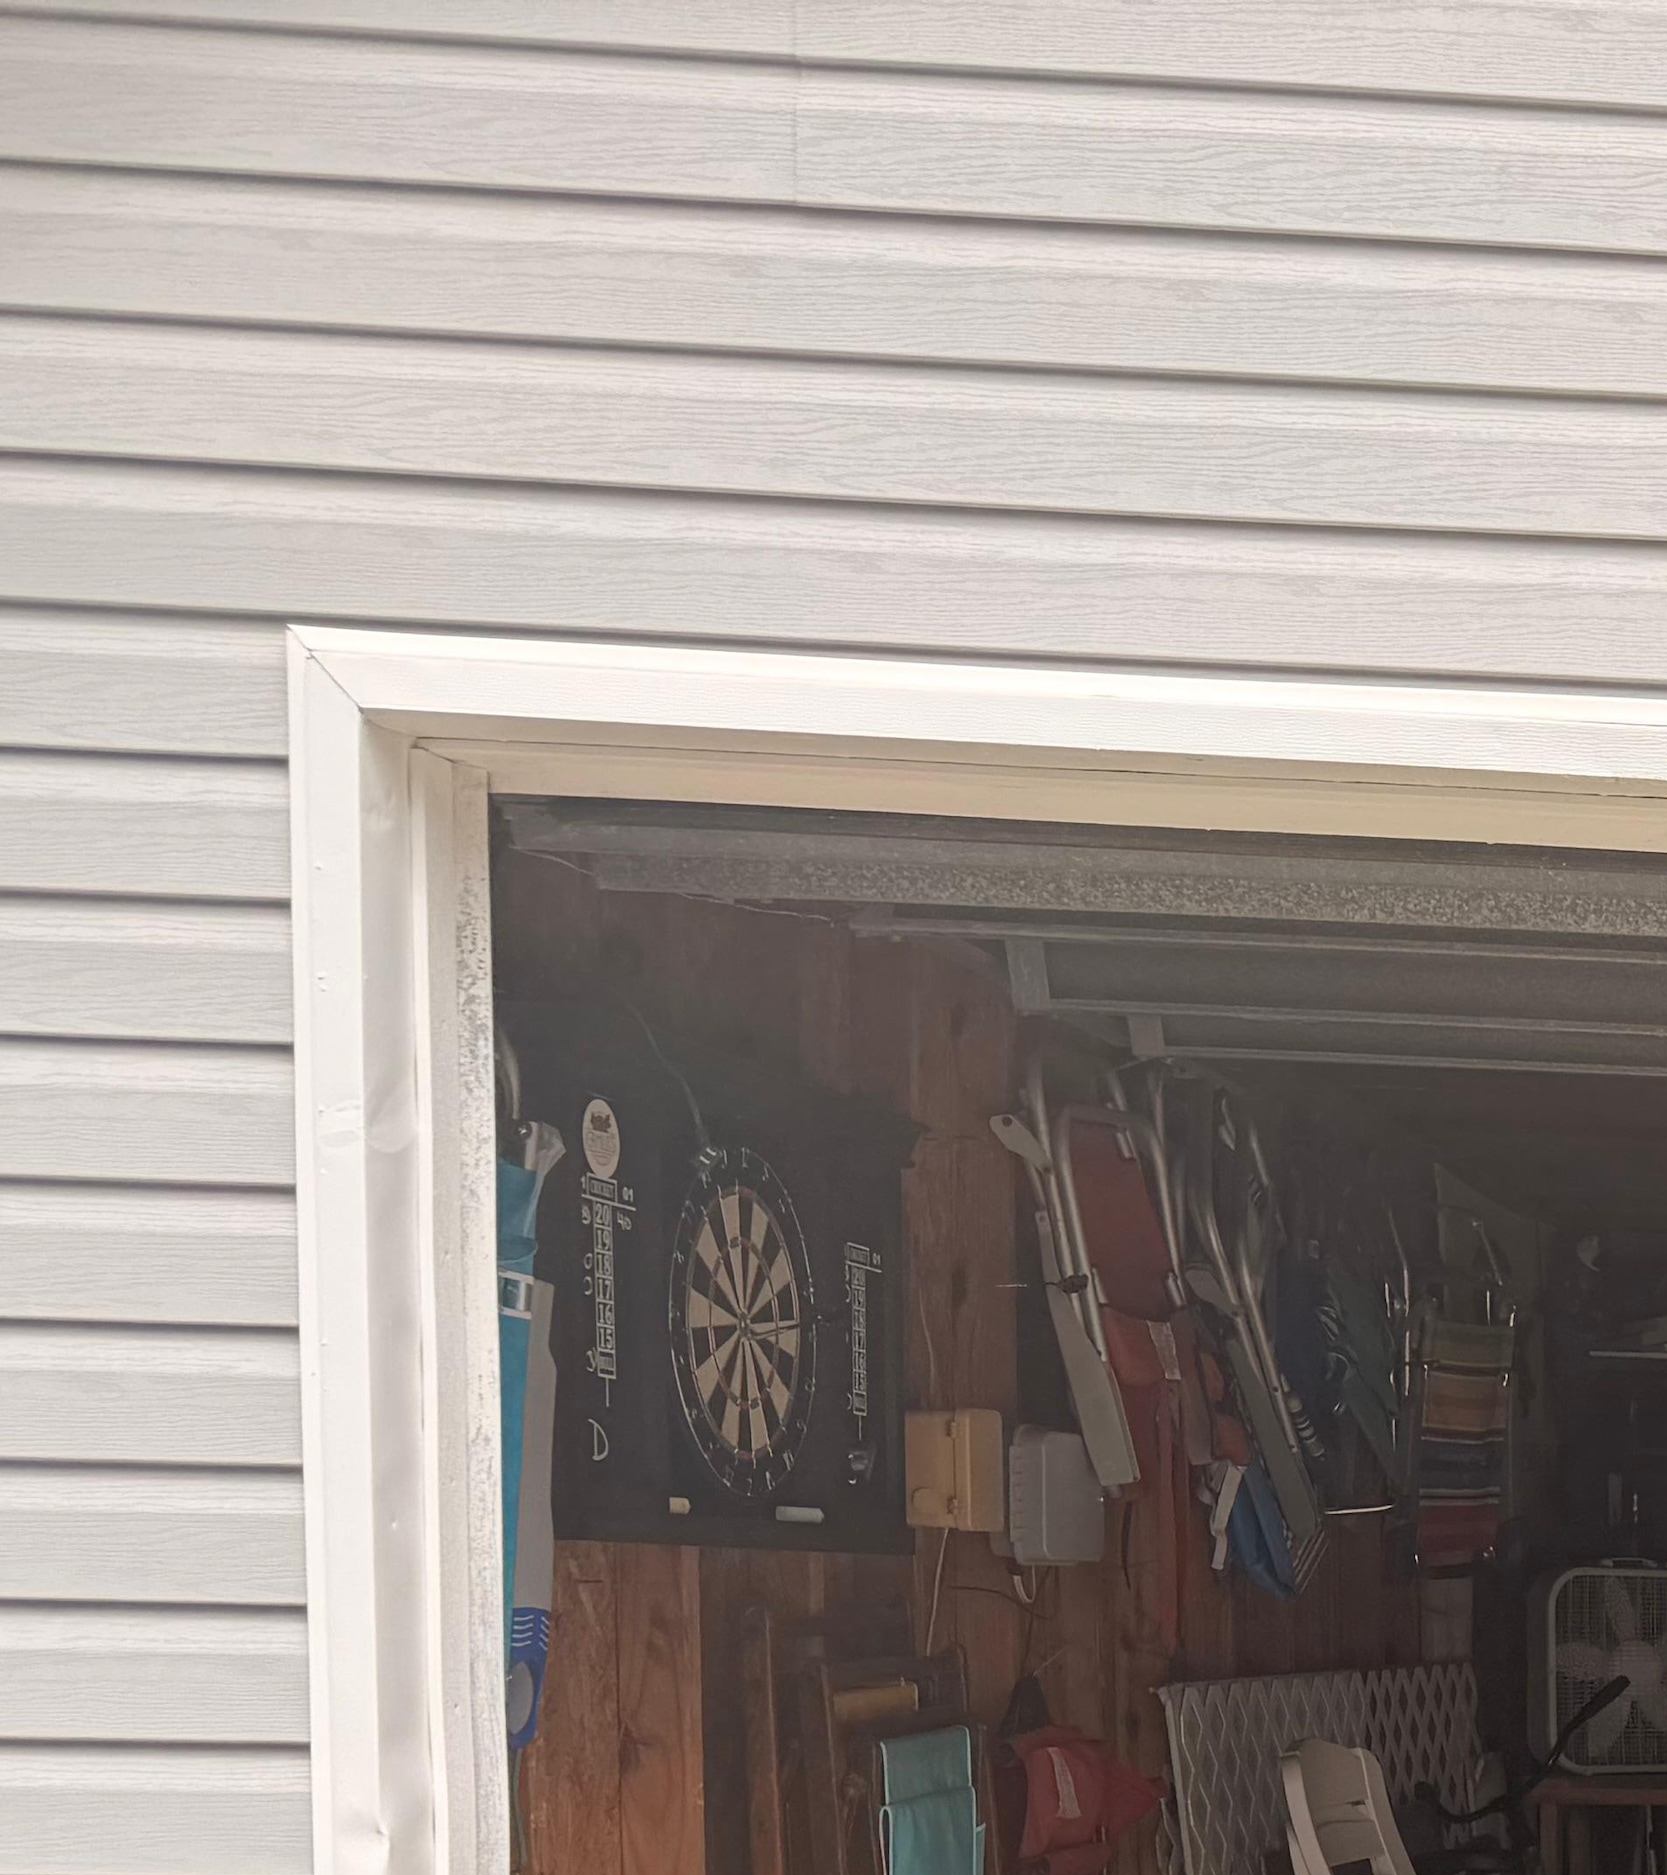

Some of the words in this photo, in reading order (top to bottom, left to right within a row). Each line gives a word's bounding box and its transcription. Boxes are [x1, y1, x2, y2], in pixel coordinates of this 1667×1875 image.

[595, 1203, 611, 1227] 20
[596, 1228, 611, 1251] 19
[597, 1253, 613, 1277] 18
[598, 1279, 612, 1300] 17
[599, 1303, 613, 1325] 16
[599, 1327, 613, 1349] 15
